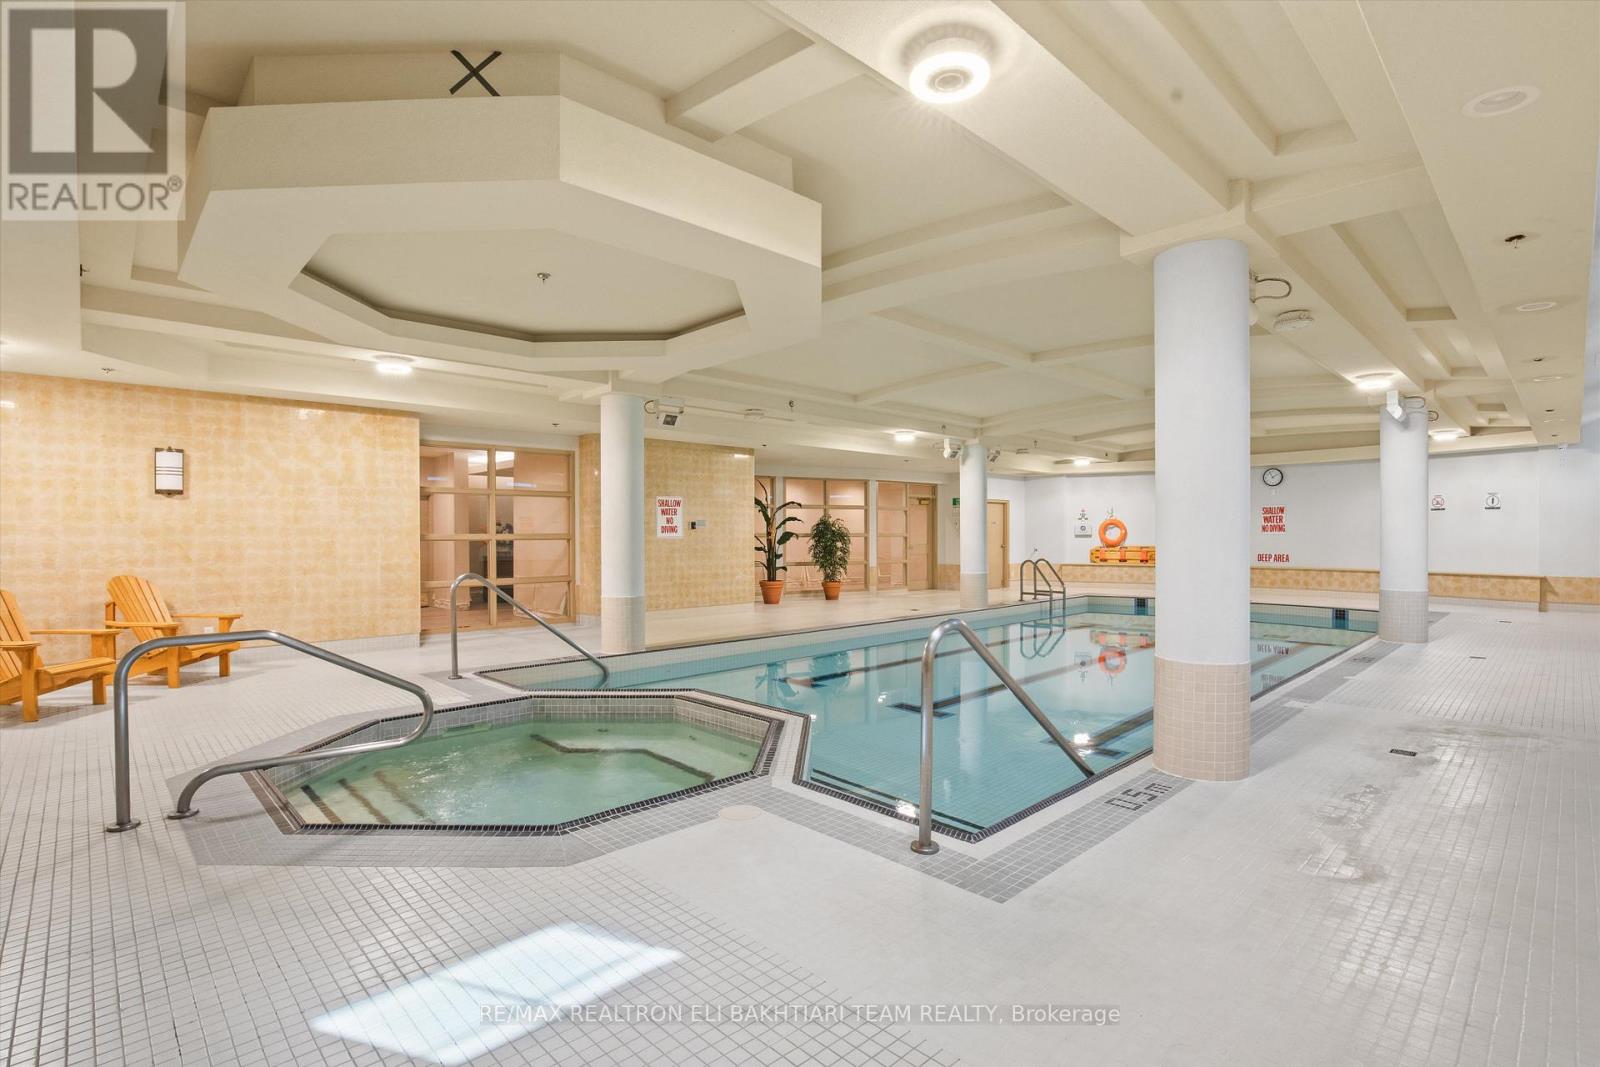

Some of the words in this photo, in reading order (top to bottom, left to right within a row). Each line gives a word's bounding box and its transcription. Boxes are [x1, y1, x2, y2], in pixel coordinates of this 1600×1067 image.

[657, 499, 681, 507] SHALLOW
[660, 508, 677, 516] WATER
[1262, 506, 1285, 514] SHALLOW
[1263, 515, 1283, 523] WATER
[660, 526, 677, 534] DIVING
[1270, 524, 1286, 532] DIVING
[1257, 553, 1273, 562] DEEP
[1273, 553, 1290, 563] AREA
